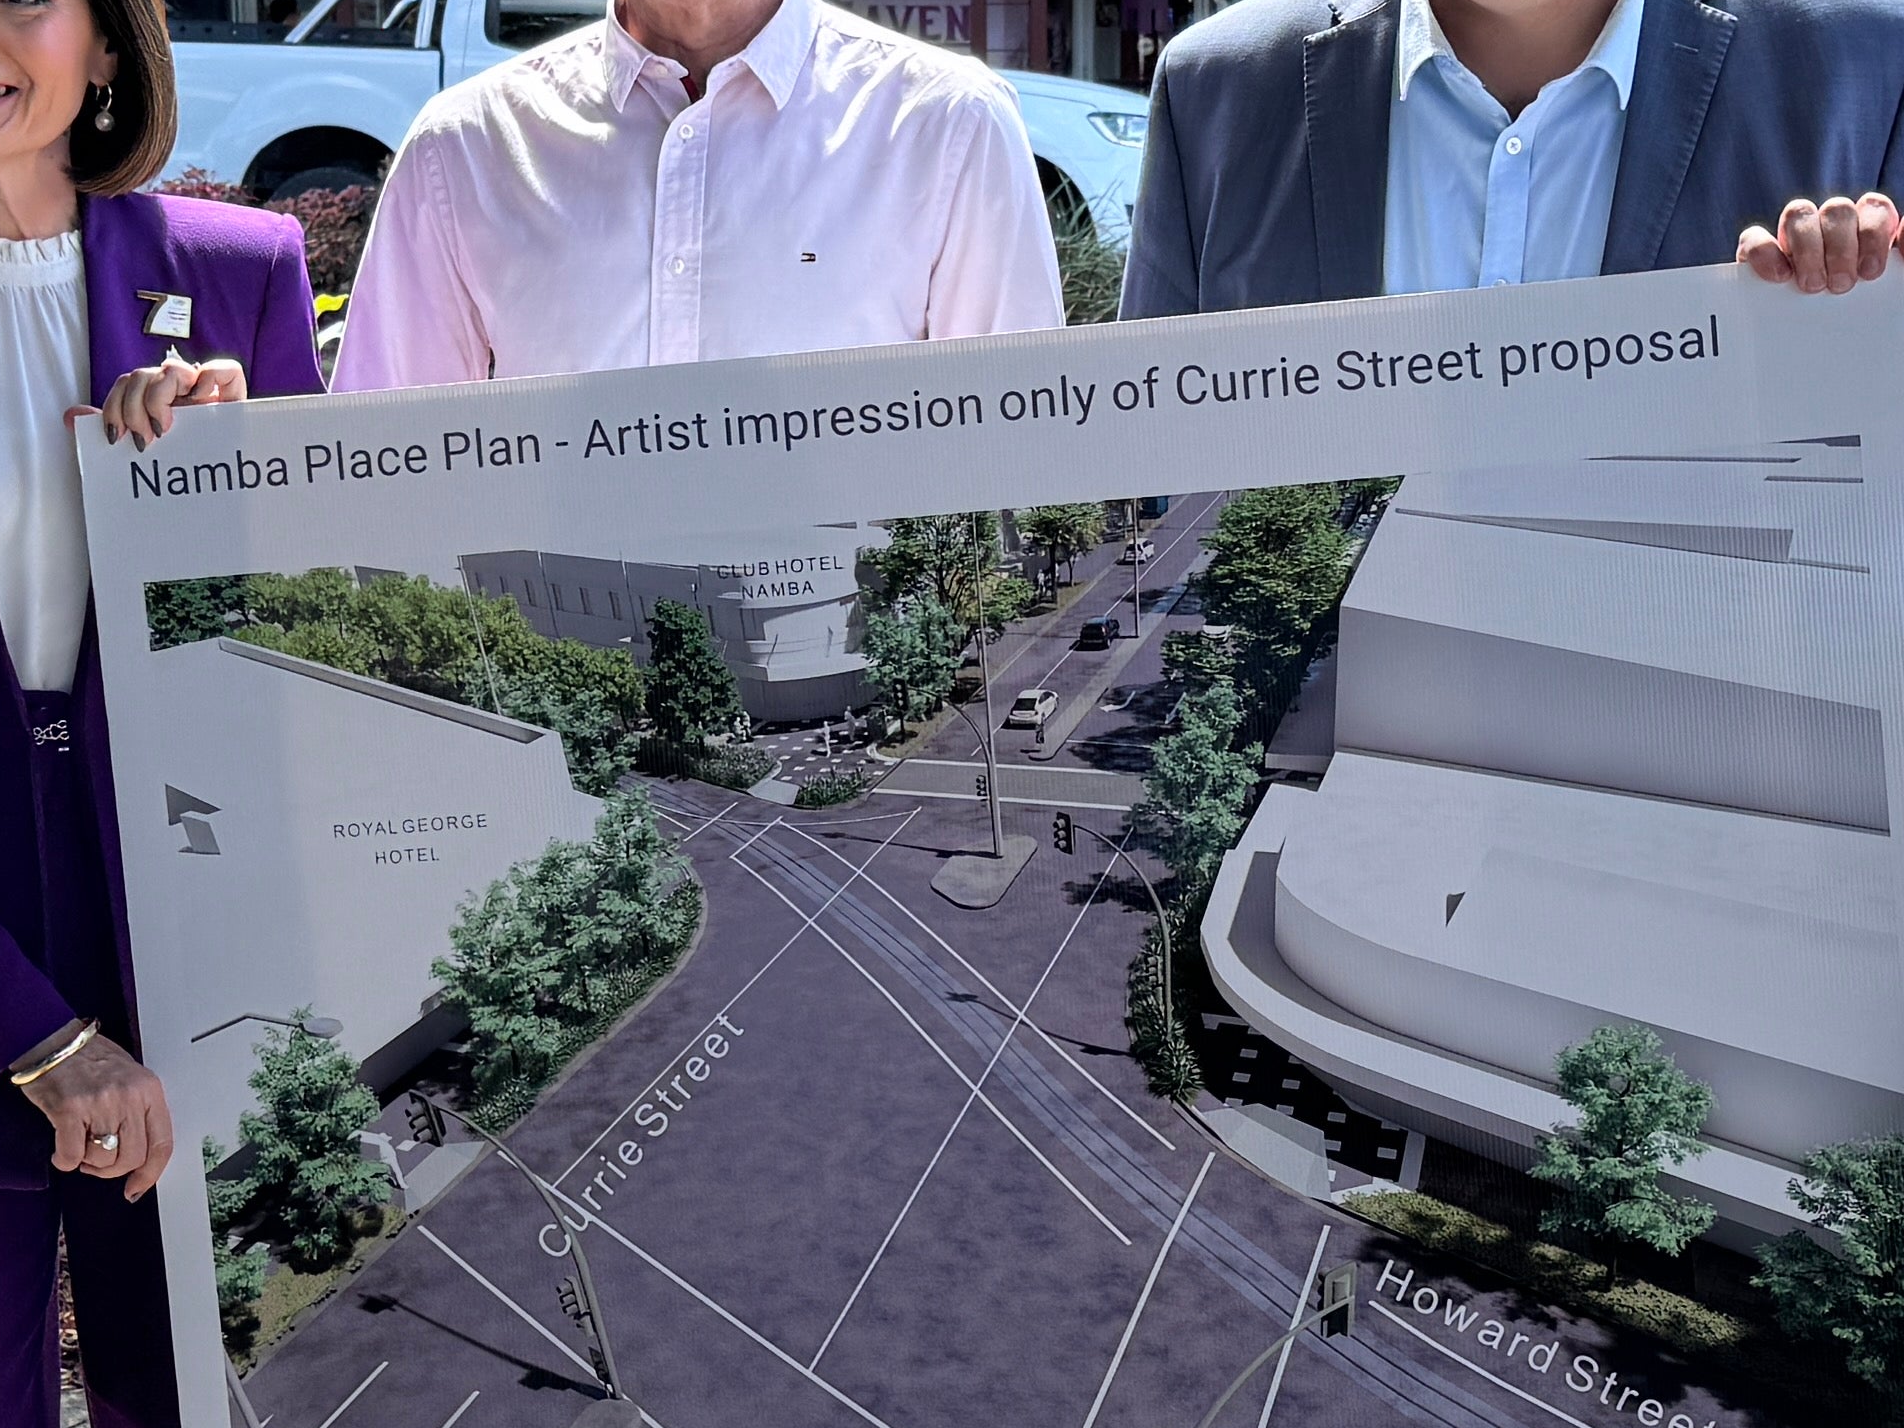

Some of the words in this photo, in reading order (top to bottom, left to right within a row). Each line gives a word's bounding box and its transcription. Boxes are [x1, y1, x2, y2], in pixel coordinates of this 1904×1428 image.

[130, 449, 290, 499] Namba
[304, 440, 428, 484] Place
[443, 427, 542, 472] Plan
[583, 410, 710, 459] Artist
[724, 389, 984, 452] impression
[1000, 375, 1097, 427] only
[1112, 366, 1161, 411] of
[1176, 357, 1321, 405] Currie
[1335, 342, 1484, 391] Street
[1499, 314, 1720, 387] proposal
[717, 561, 770, 580] CLUB
[775, 555, 845, 575] HOTEL
[741, 580, 815, 599] NAMBA
[333, 820, 398, 839] ROYAL
[402, 813, 488, 834] GEORGE
[375, 847, 440, 865] HOTEL
[537, 1133, 646, 1261] Currie
[632, 1012, 747, 1141] Street
[1374, 1258, 1561, 1376] Howard
